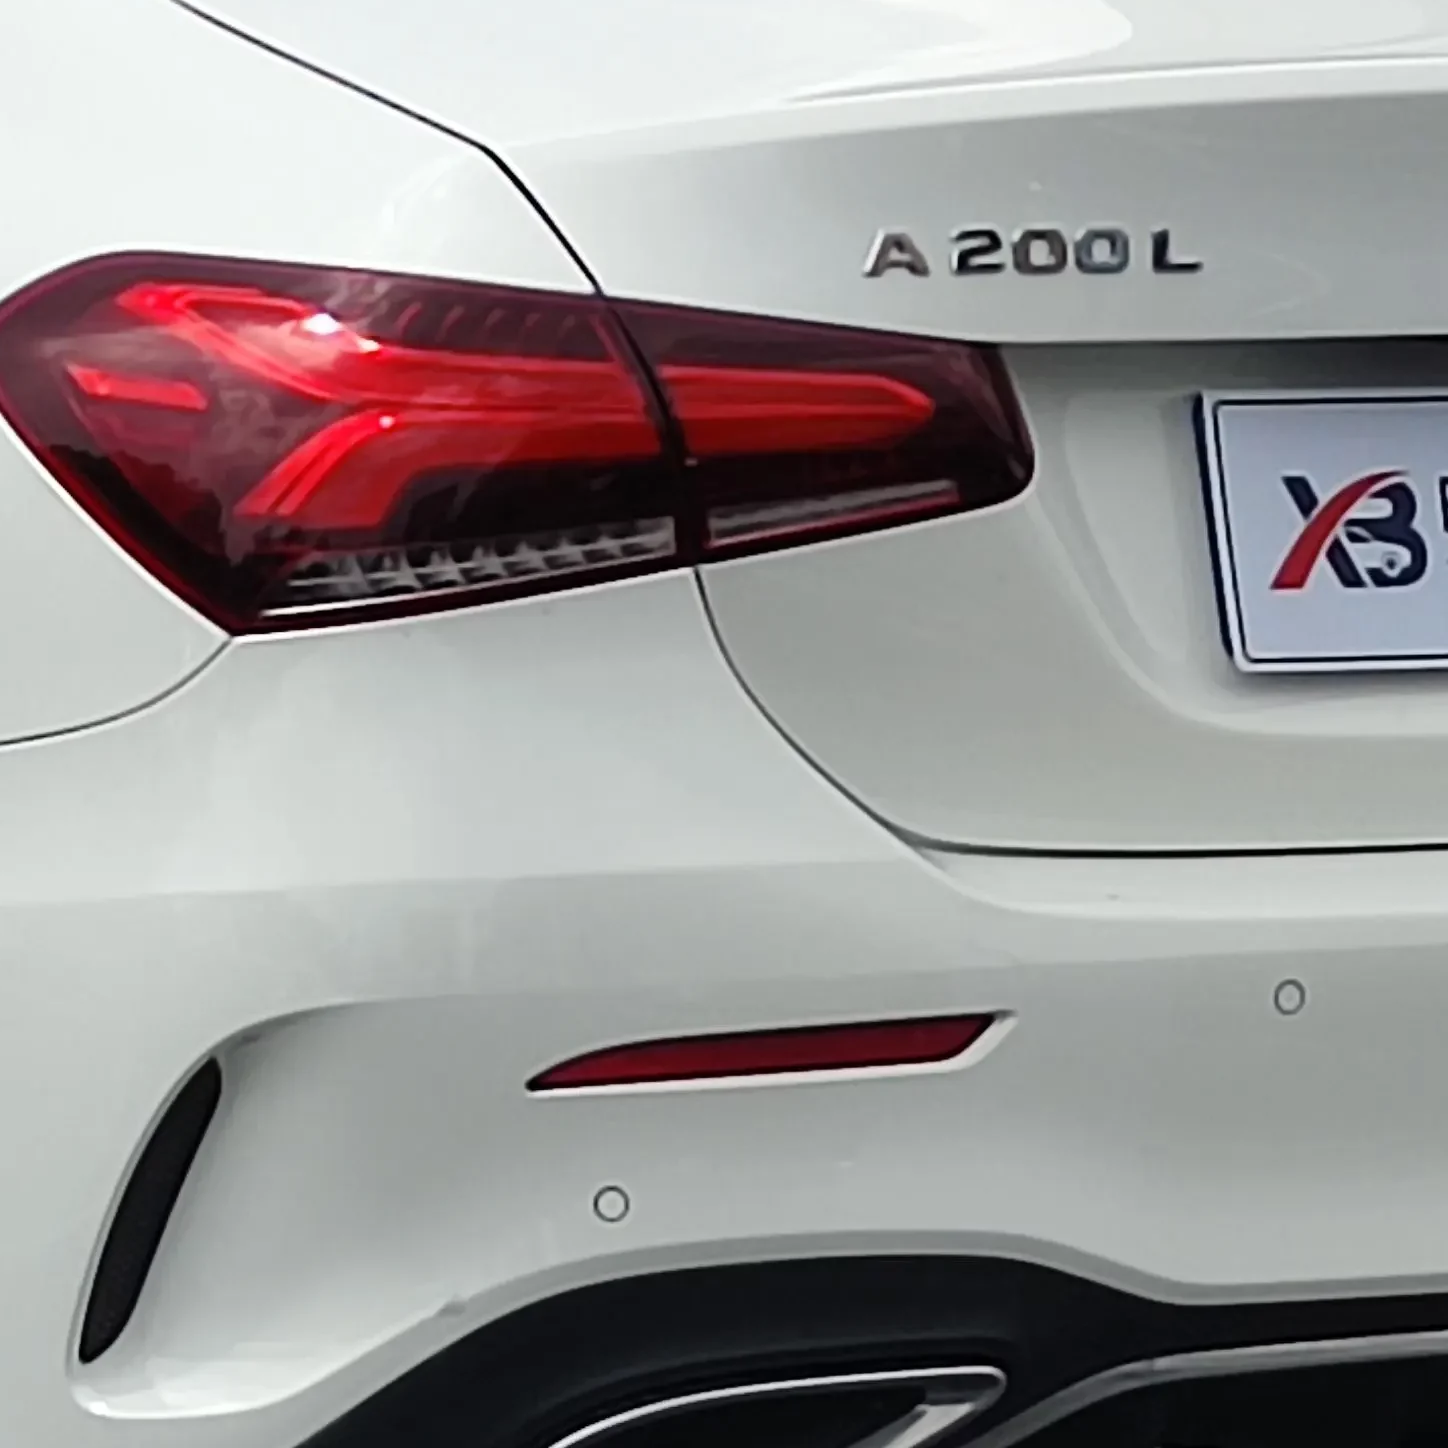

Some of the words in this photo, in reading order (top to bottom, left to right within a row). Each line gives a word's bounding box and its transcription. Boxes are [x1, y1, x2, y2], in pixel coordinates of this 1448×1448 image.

[862, 227, 931, 278] A
[950, 226, 1131, 276] 200
[1151, 228, 1203, 275] L
